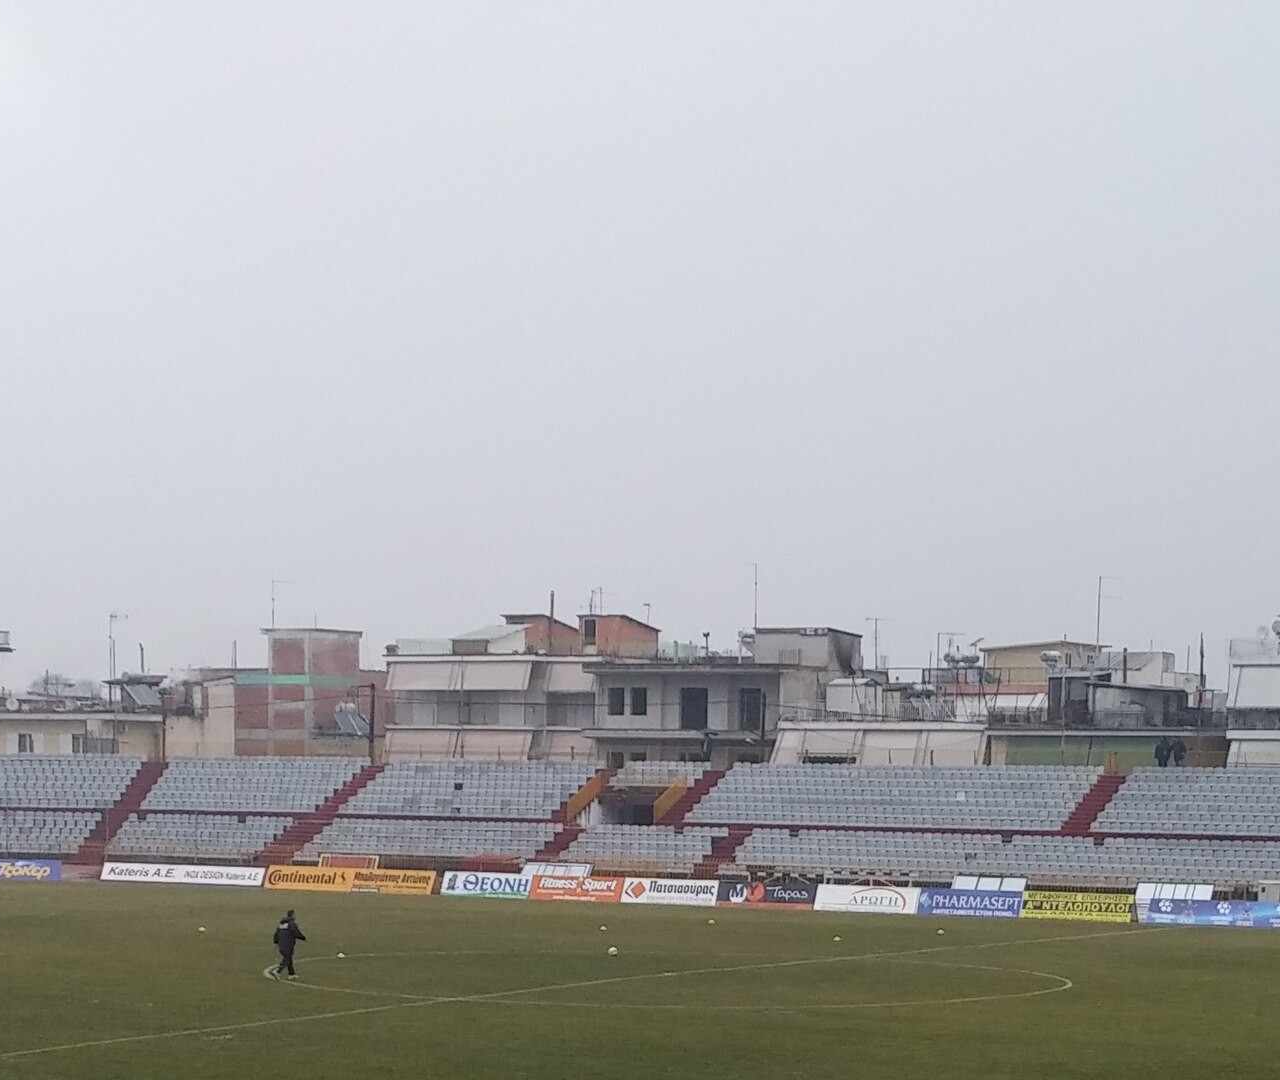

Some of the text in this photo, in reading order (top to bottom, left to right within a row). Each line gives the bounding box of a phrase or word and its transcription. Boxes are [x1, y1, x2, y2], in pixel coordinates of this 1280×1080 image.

[108, 867, 149, 877] Kateris
[268, 869, 337, 885] Continental
[539, 877, 617, 891] Fitness Sport
[931, 894, 1021, 910] PHARMASEPT
